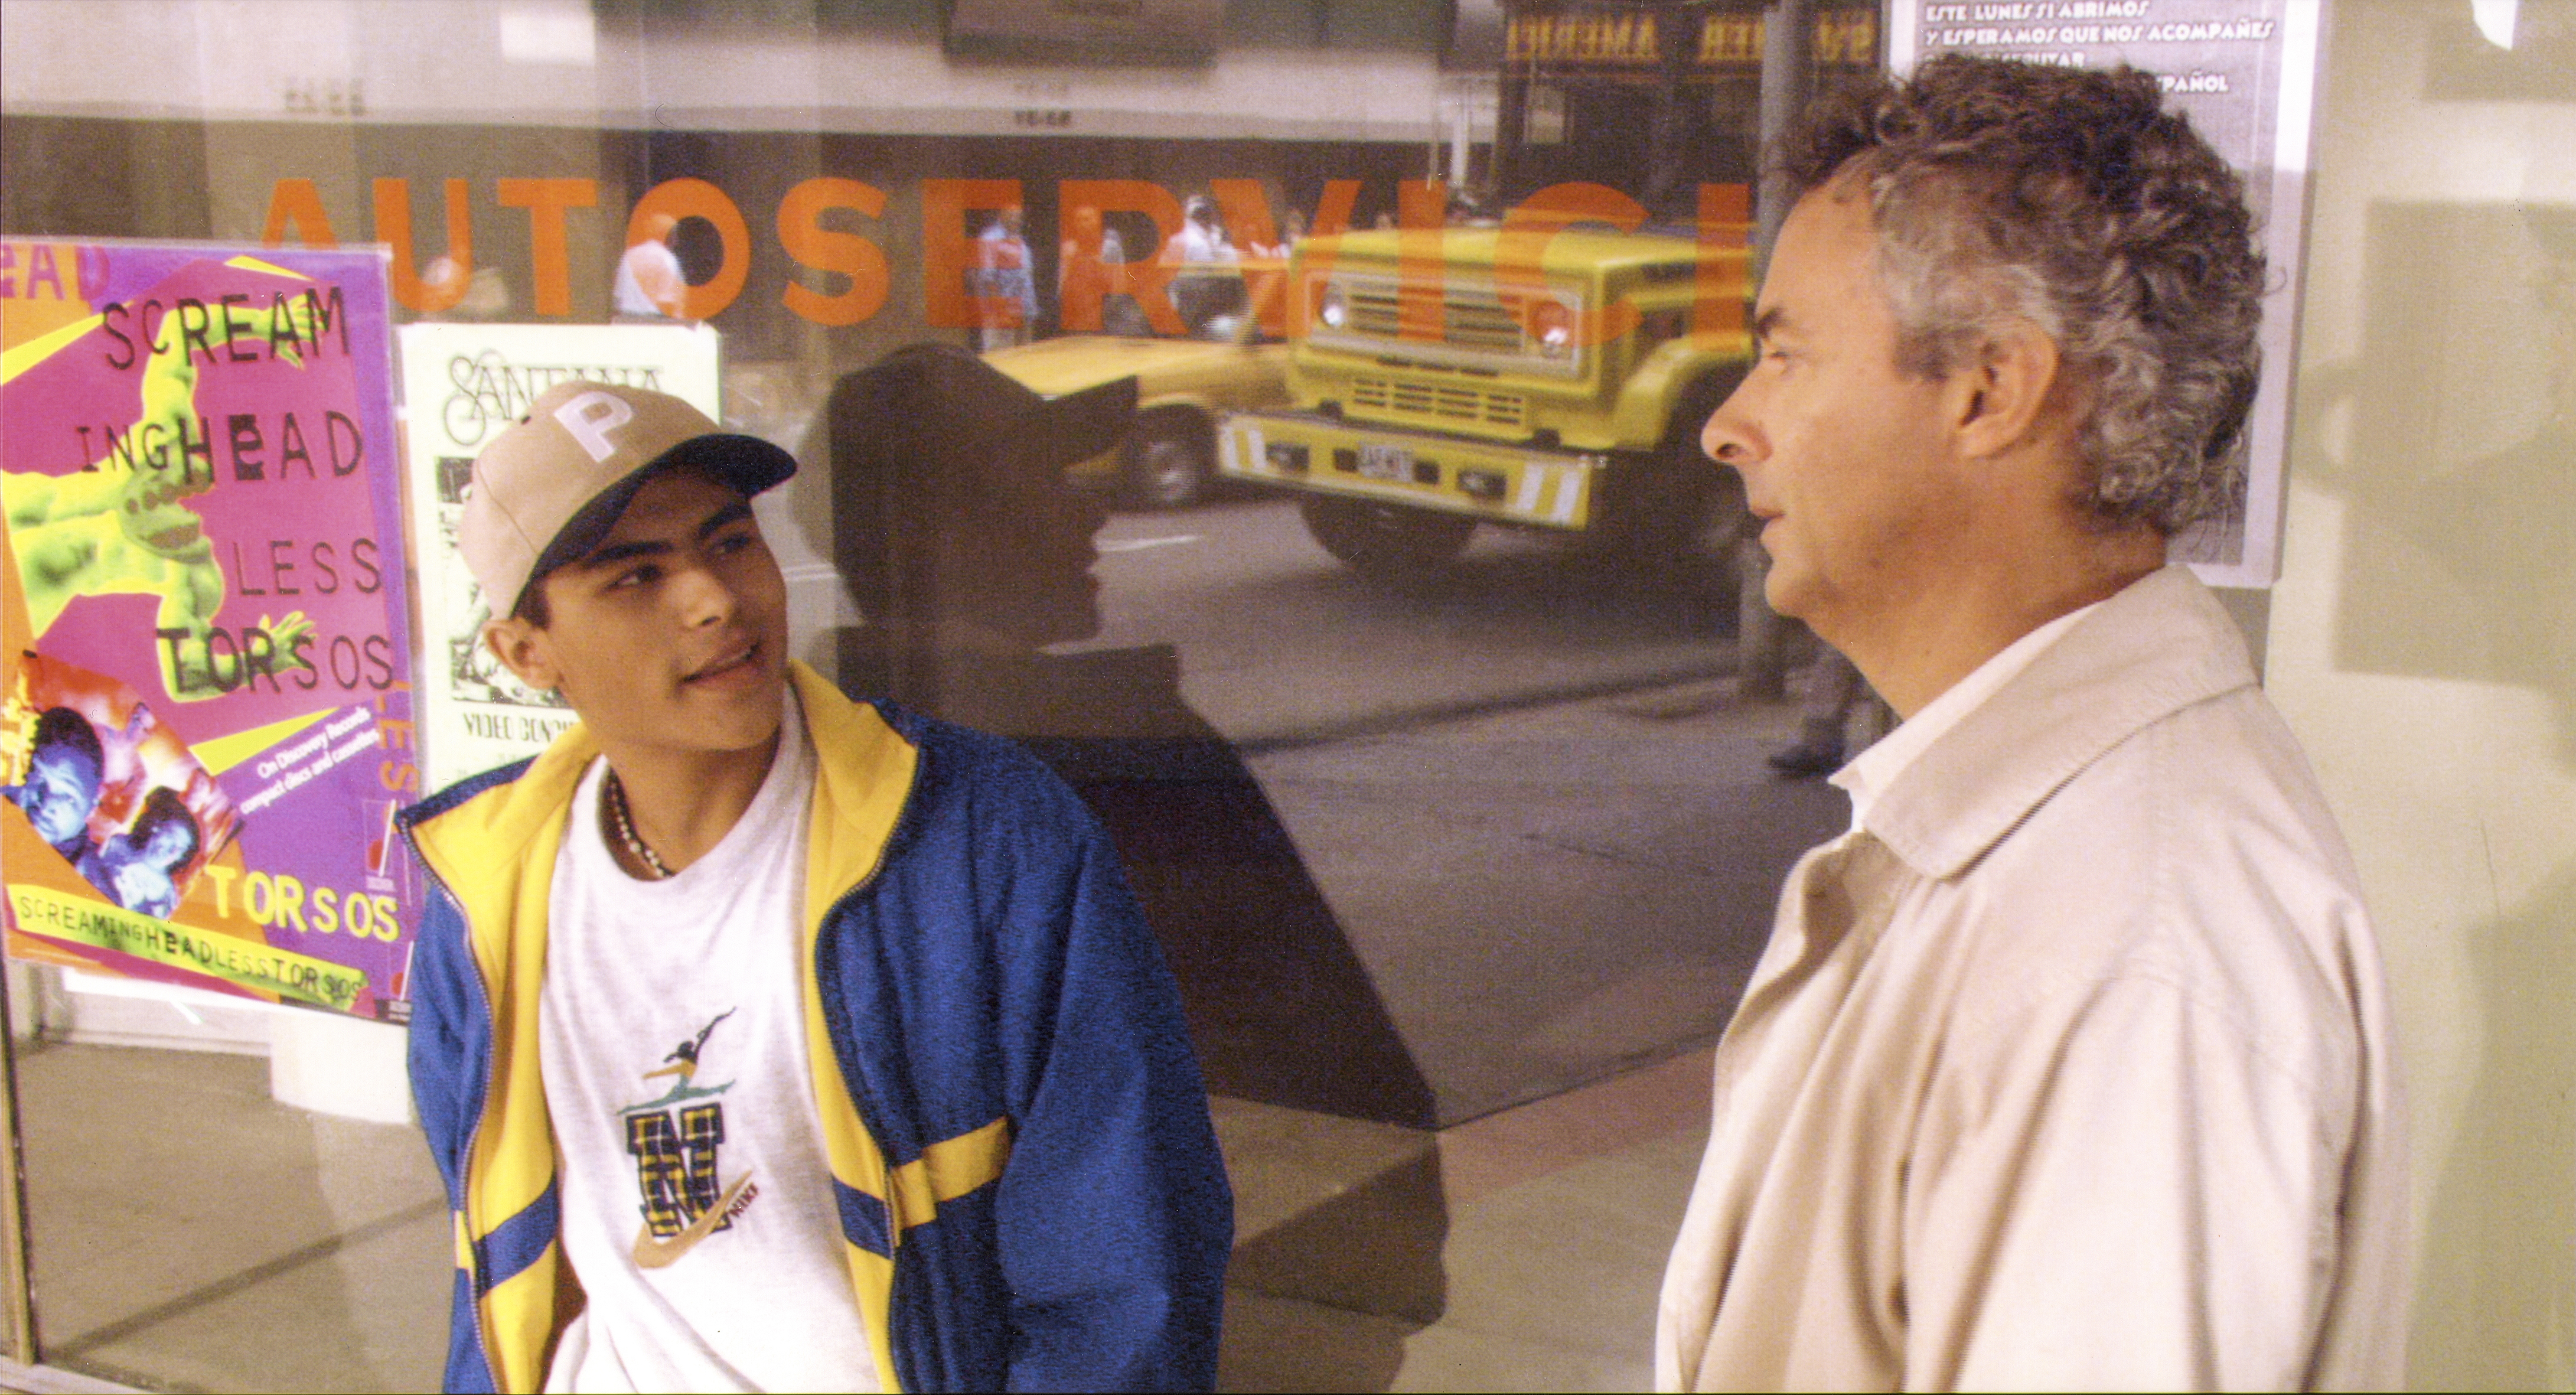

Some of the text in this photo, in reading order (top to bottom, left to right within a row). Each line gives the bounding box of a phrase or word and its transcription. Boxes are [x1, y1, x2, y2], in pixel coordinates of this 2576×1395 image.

[1926, 1, 2148, 21] ESTE LUNES SI ABRIMOS
[1926, 17, 2273, 45] Y ESPERAMOS QUE NOS ACOMPAÑES
[2157, 69, 2229, 93] PAÑOL
[102, 286, 350, 370] SCREAM
[554, 390, 633, 463] P
[233, 538, 382, 595] LESS
[155, 627, 394, 693] TORSOS
[257, 706, 371, 778] On Discovery Records
[463, 712, 511, 741] VIDEO
[240, 779, 286, 814] compact
[283, 767, 315, 790] discs
[311, 750, 334, 775] and
[205, 865, 399, 942] TORSOS
[727, 1182, 759, 1217] NIKE
